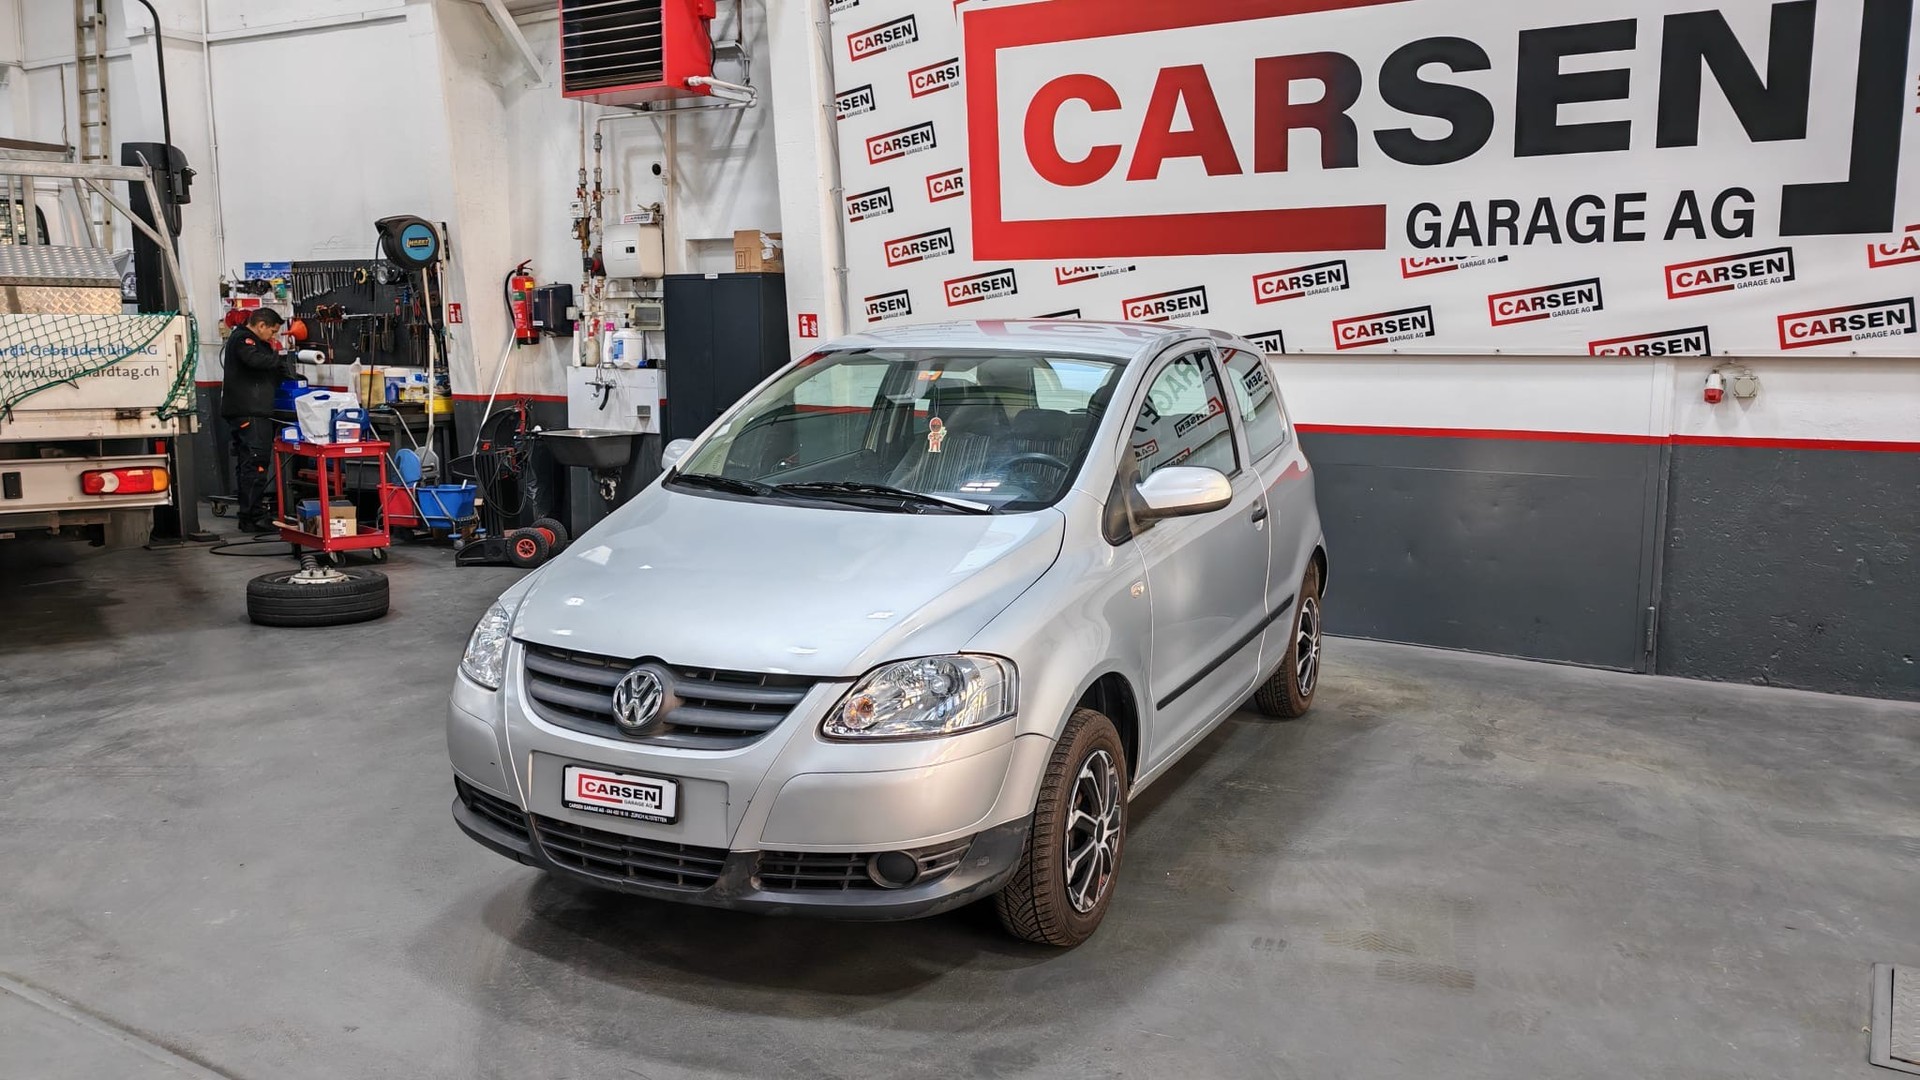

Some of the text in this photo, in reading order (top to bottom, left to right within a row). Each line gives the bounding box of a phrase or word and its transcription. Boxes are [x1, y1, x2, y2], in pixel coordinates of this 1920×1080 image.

[855, 23, 912, 52] CARSEN
[888, 41, 904, 50] GARAGE
[1024, 1, 1818, 185] CARSEN
[846, 110, 861, 118] GARAGE
[873, 130, 931, 155] CARSEN
[906, 147, 922, 155] GARAGE
[865, 211, 880, 219] GARAGE
[1406, 187, 1756, 249] GARAGE AG
[891, 236, 949, 258] CARSEN
[924, 252, 940, 260] GARAGE
[1460, 260, 1485, 269] GARAGE
[1676, 257, 1784, 288] CARSEN
[1261, 269, 1342, 294] CARSEN
[1737, 276, 1781, 290] GARAGE AG
[951, 276, 1011, 299] CARSEN
[1307, 287, 1329, 296] GARAGE
[986, 292, 1003, 300] GARAGE
[1130, 294, 1201, 320] CARSEN
[1498, 288, 1594, 317] CARSEN
[882, 312, 898, 320] GARAGE
[1170, 312, 1190, 320] GARAGE
[1552, 308, 1579, 318] GARAGE
[1341, 314, 1426, 341] CARSEN
[1789, 308, 1905, 339] CARSEN
[1390, 334, 1412, 343] GARAGE
[1855, 331, 1887, 341] GARAGE
[138, 345, 157, 355] AG
[584, 781, 657, 802] CARSEN
[624, 799, 645, 807] GARAGE
